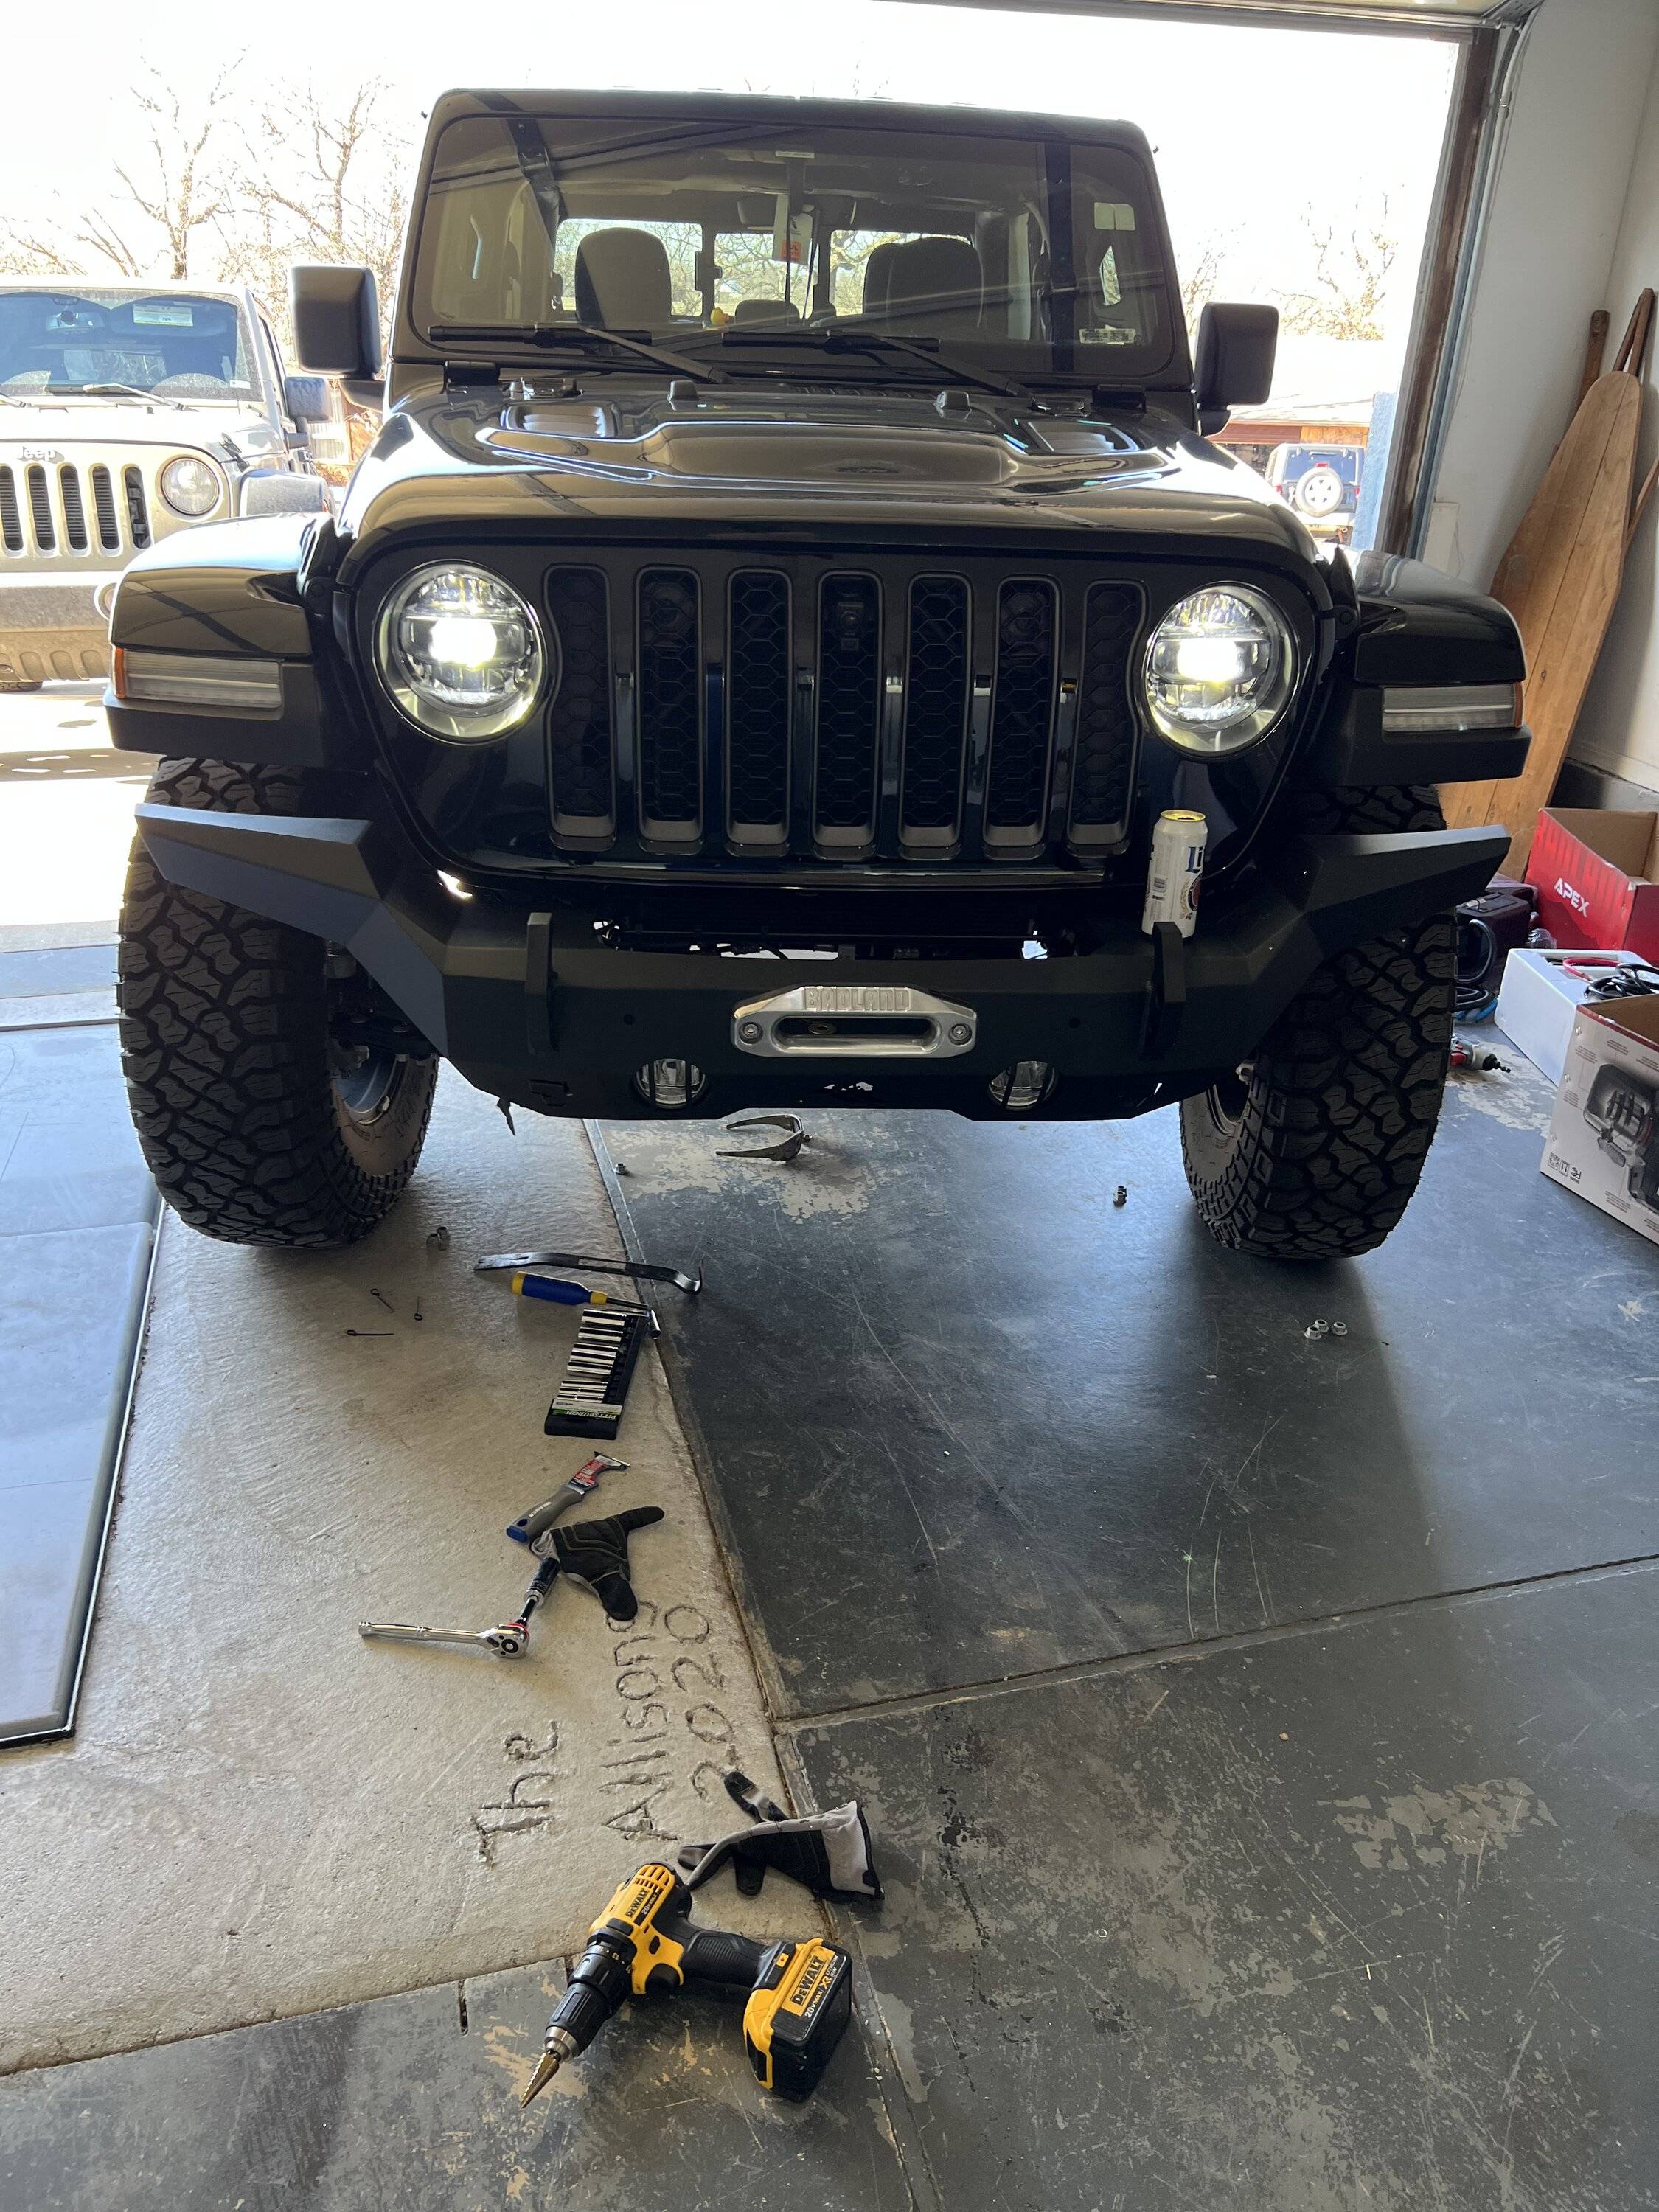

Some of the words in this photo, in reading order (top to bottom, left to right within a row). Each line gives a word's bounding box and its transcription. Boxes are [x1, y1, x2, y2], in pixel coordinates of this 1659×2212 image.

[18, 445, 56, 462] Jeep
[1185, 846, 1203, 873] Li
[1554, 877, 1590, 918] APEX
[804, 987, 910, 1011] BADLAND
[566, 1411, 617, 1419] PITTSBURGH
[665, 1603, 743, 1801] 2020
[470, 1720, 559, 1867] The
[819, 1975, 832, 1990] XR
